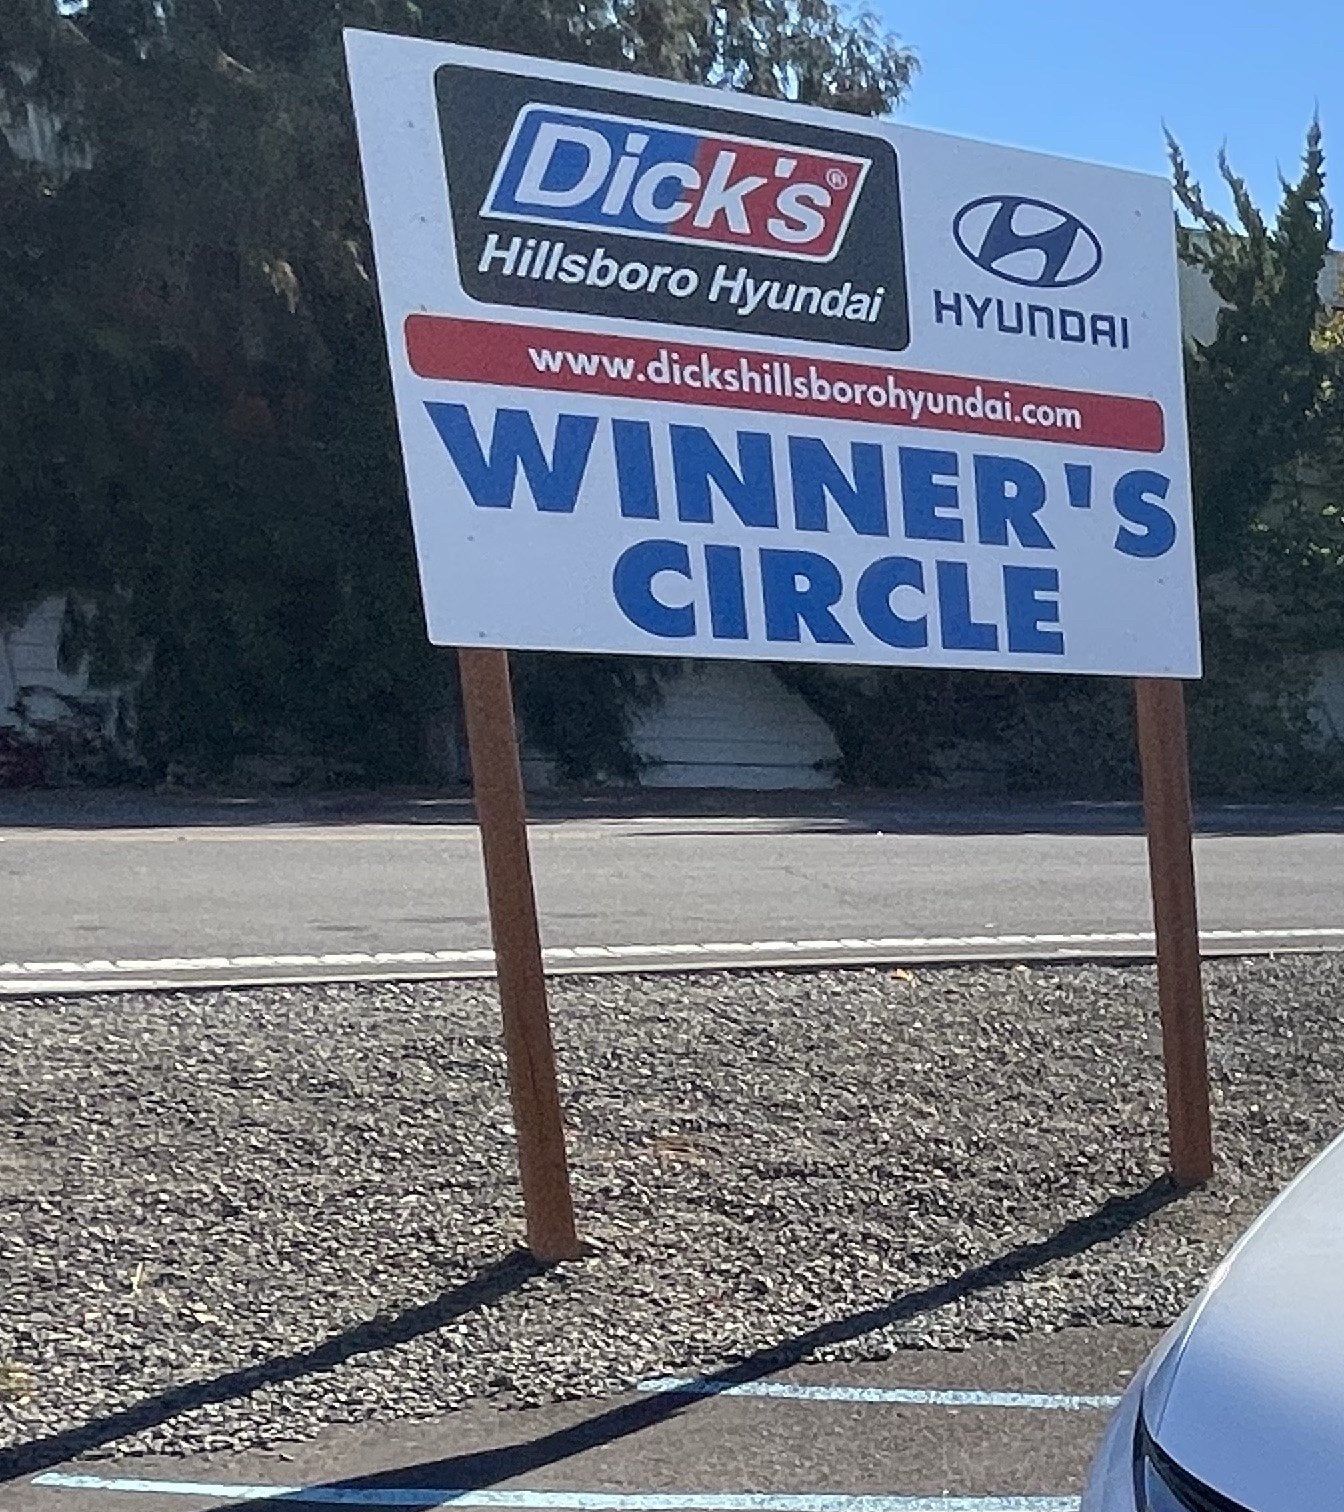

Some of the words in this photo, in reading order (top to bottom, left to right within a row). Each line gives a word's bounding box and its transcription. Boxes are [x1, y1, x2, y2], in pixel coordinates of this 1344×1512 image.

[512, 123, 837, 248] Dick's
[478, 233, 698, 300] Hillsboro
[707, 262, 886, 322] Hyundai
[934, 289, 1130, 350] HYUNDAI
[527, 339, 1082, 432] www.dickshillsborohyundai.com
[423, 401, 1178, 559] WINNER'S
[611, 538, 1066, 657] CIRCLE
